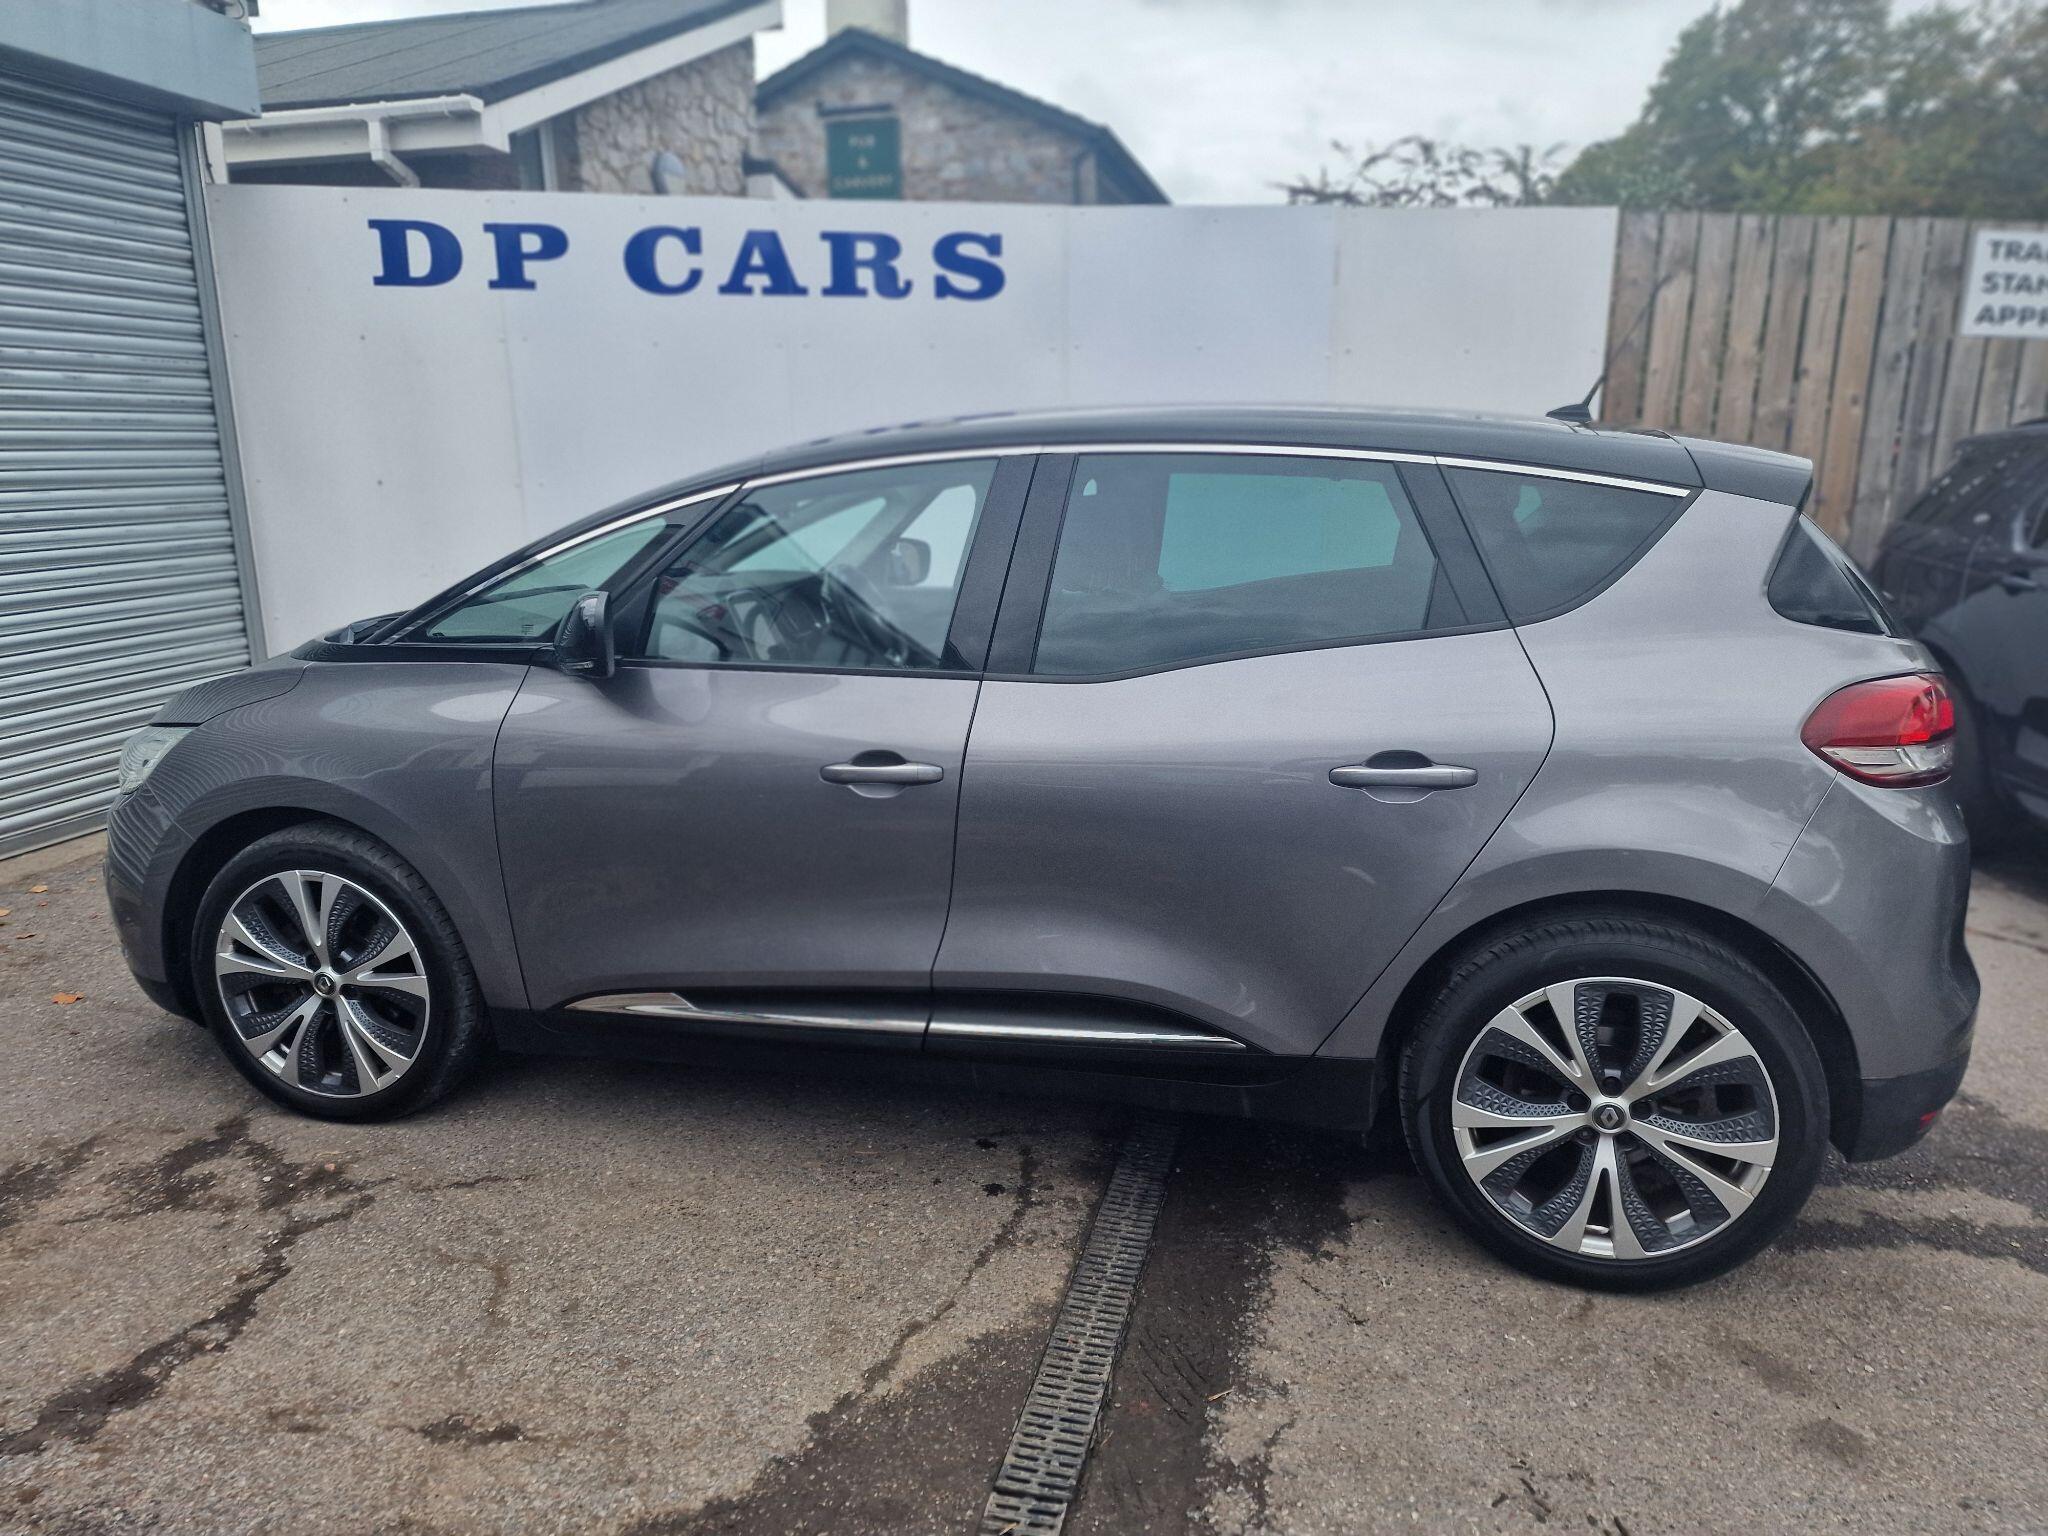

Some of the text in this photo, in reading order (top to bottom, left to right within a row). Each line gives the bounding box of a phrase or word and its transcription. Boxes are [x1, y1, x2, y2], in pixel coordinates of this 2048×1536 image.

[367, 218, 1007, 301] DP CARS
[1988, 238, 2048, 262] TRA
